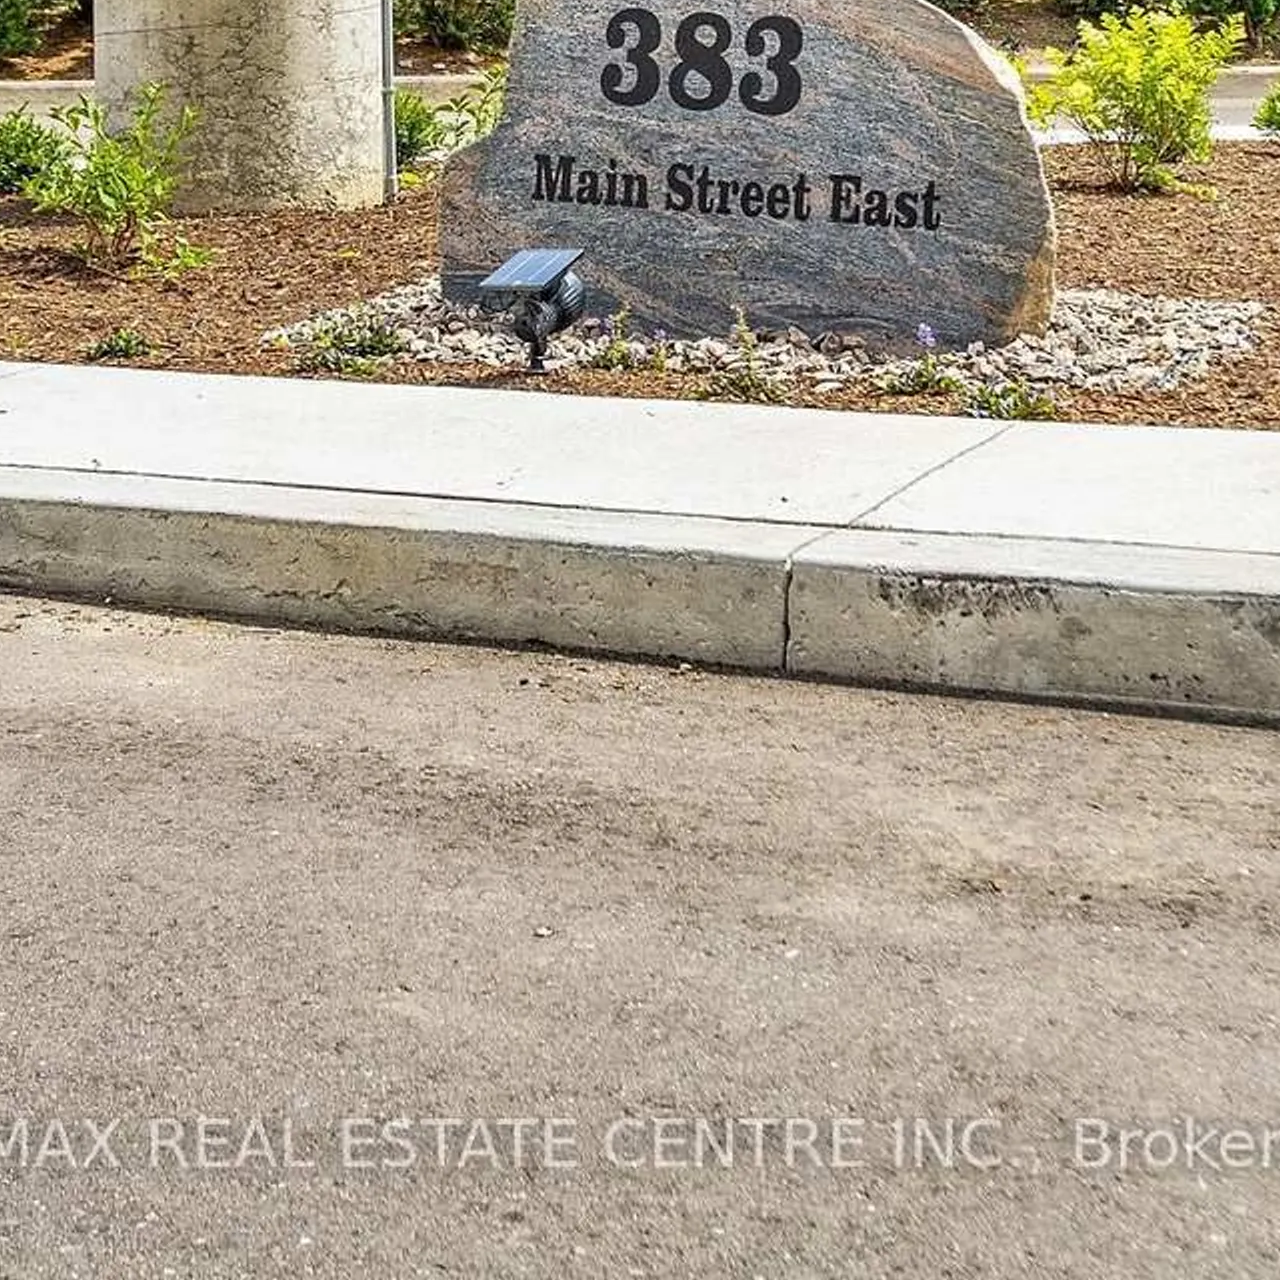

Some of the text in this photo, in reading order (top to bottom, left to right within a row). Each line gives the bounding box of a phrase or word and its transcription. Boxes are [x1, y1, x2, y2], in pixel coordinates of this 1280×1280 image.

[600, 7, 804, 116] 383
[531, 153, 942, 231] Main Street East
